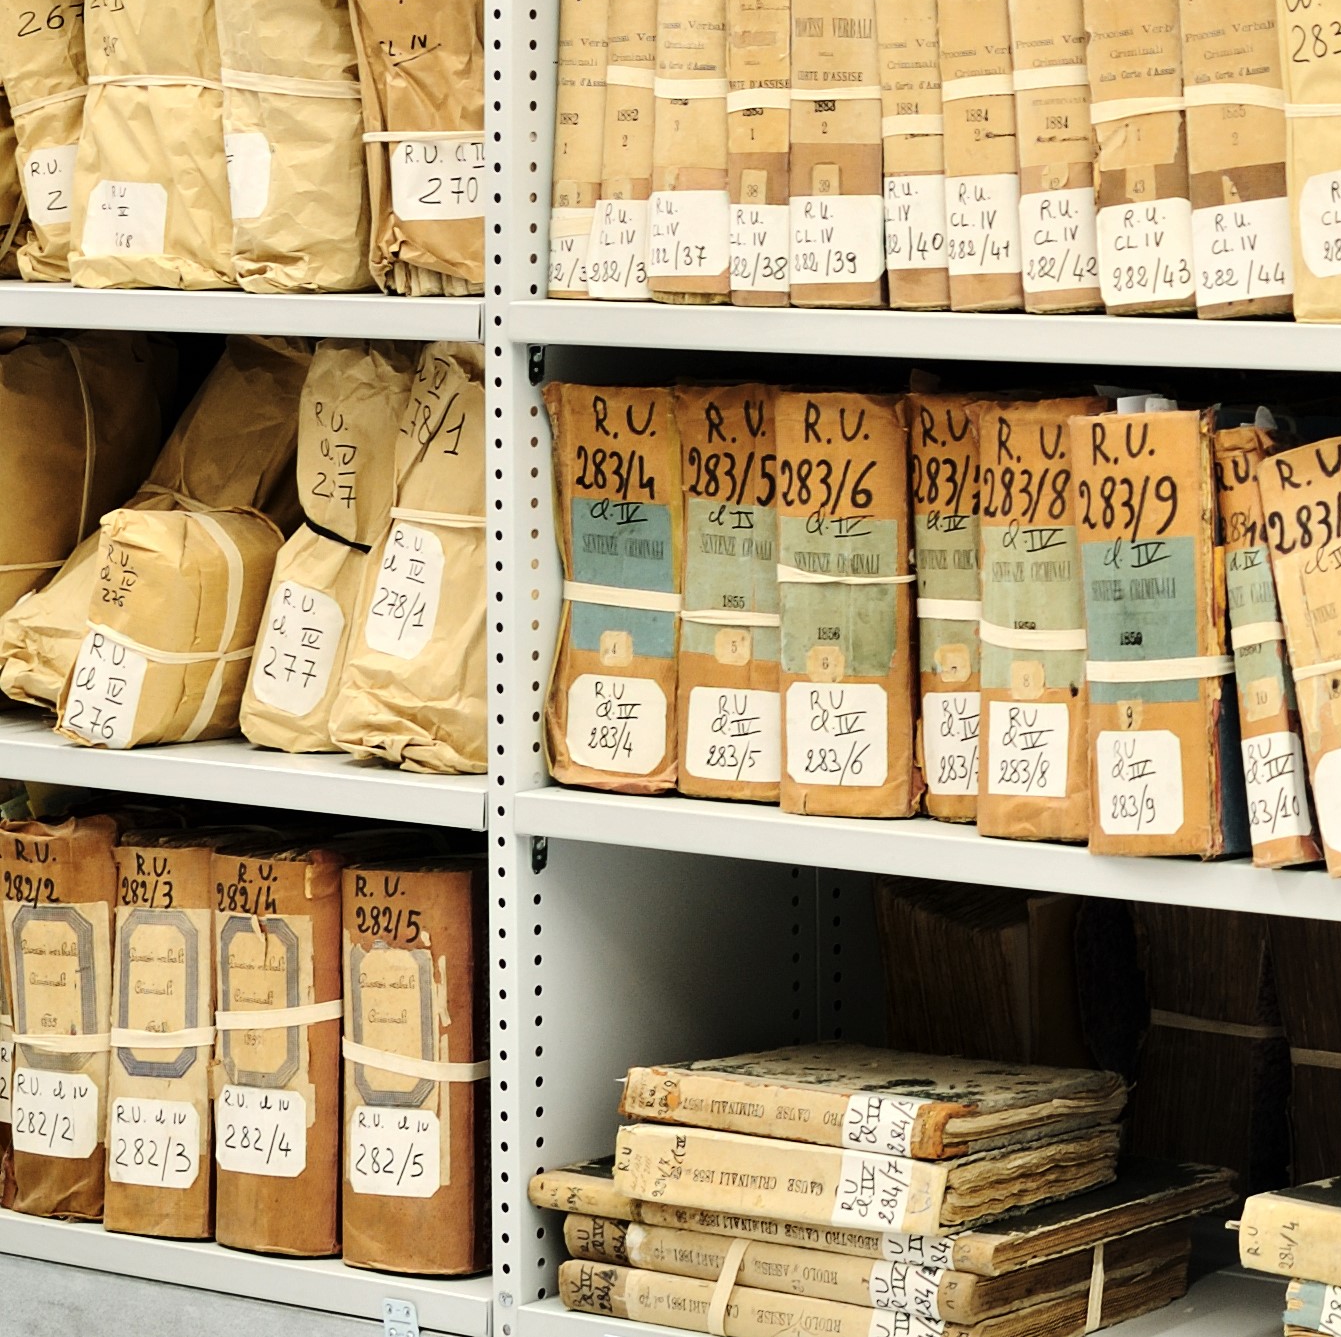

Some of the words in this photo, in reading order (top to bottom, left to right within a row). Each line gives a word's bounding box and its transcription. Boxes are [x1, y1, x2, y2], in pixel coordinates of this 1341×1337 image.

[965, 109, 988, 121] 1884
[419, 177, 477, 205] 270
[1113, 262, 1191, 293] 282/43
[1202, 258, 1286, 289] 282/44
[576, 448, 655, 500] 283/4
[689, 449, 777, 507] 283/5
[781, 459, 877, 513] 283/6
[983, 468, 1071, 522] 283/8
[1079, 474, 1177, 540] 283/9
[372, 587, 424, 640] 278/1
[722, 596, 744, 608] 1855
[264, 646, 316, 688] 277
[68, 700, 114, 740] 276
[589, 724, 633, 759] 283/4
[707, 744, 761, 780] 283/5
[806, 741, 870, 786] 283/6
[999, 758, 1050, 791] 283/8
[1112, 795, 1155, 836] 283/9
[5, 872, 59, 906] 282/2
[122, 879, 173, 909] 282/3
[217, 883, 277, 914] 282/4
[356, 906, 421, 942] 282/5
[16, 1110, 73, 1147] 282/2
[225, 1125, 291, 1164] 282/4
[115, 1139, 191, 1181] 282/3
[356, 1143, 424, 1185] 282/5
